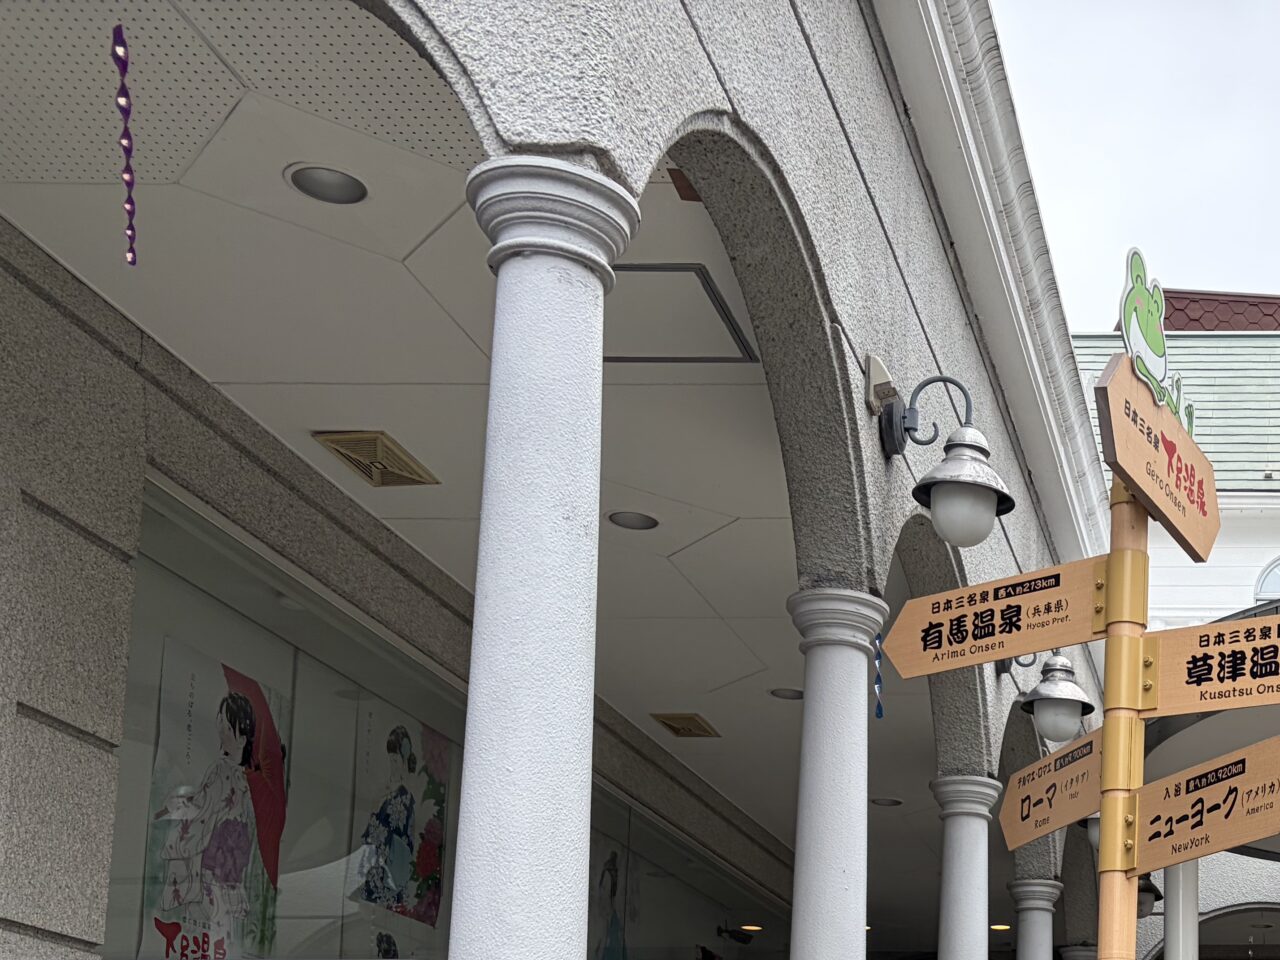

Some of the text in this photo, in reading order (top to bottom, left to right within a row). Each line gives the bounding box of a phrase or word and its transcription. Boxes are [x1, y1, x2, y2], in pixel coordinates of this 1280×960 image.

[1124, 398, 1160, 453] 日本三名泉
[1160, 430, 1207, 517] 下呂温泉
[1146, 461, 1186, 517] Gero Onsen
[932, 590, 990, 614] 日本三名泉
[920, 604, 1022, 651] 有馬温泉
[1026, 615, 1071, 630] Hyogo Pref.
[1199, 626, 1272, 648] 日本三名泉
[932, 641, 1005, 663] Arima Onsen
[1199, 687, 1252, 701] Kusatsu
[1021, 782, 1057, 822] ローマ
[1148, 785, 1238, 842] ニューヨーク
[1246, 802, 1274, 816] America
[1034, 816, 1050, 829] Rome
